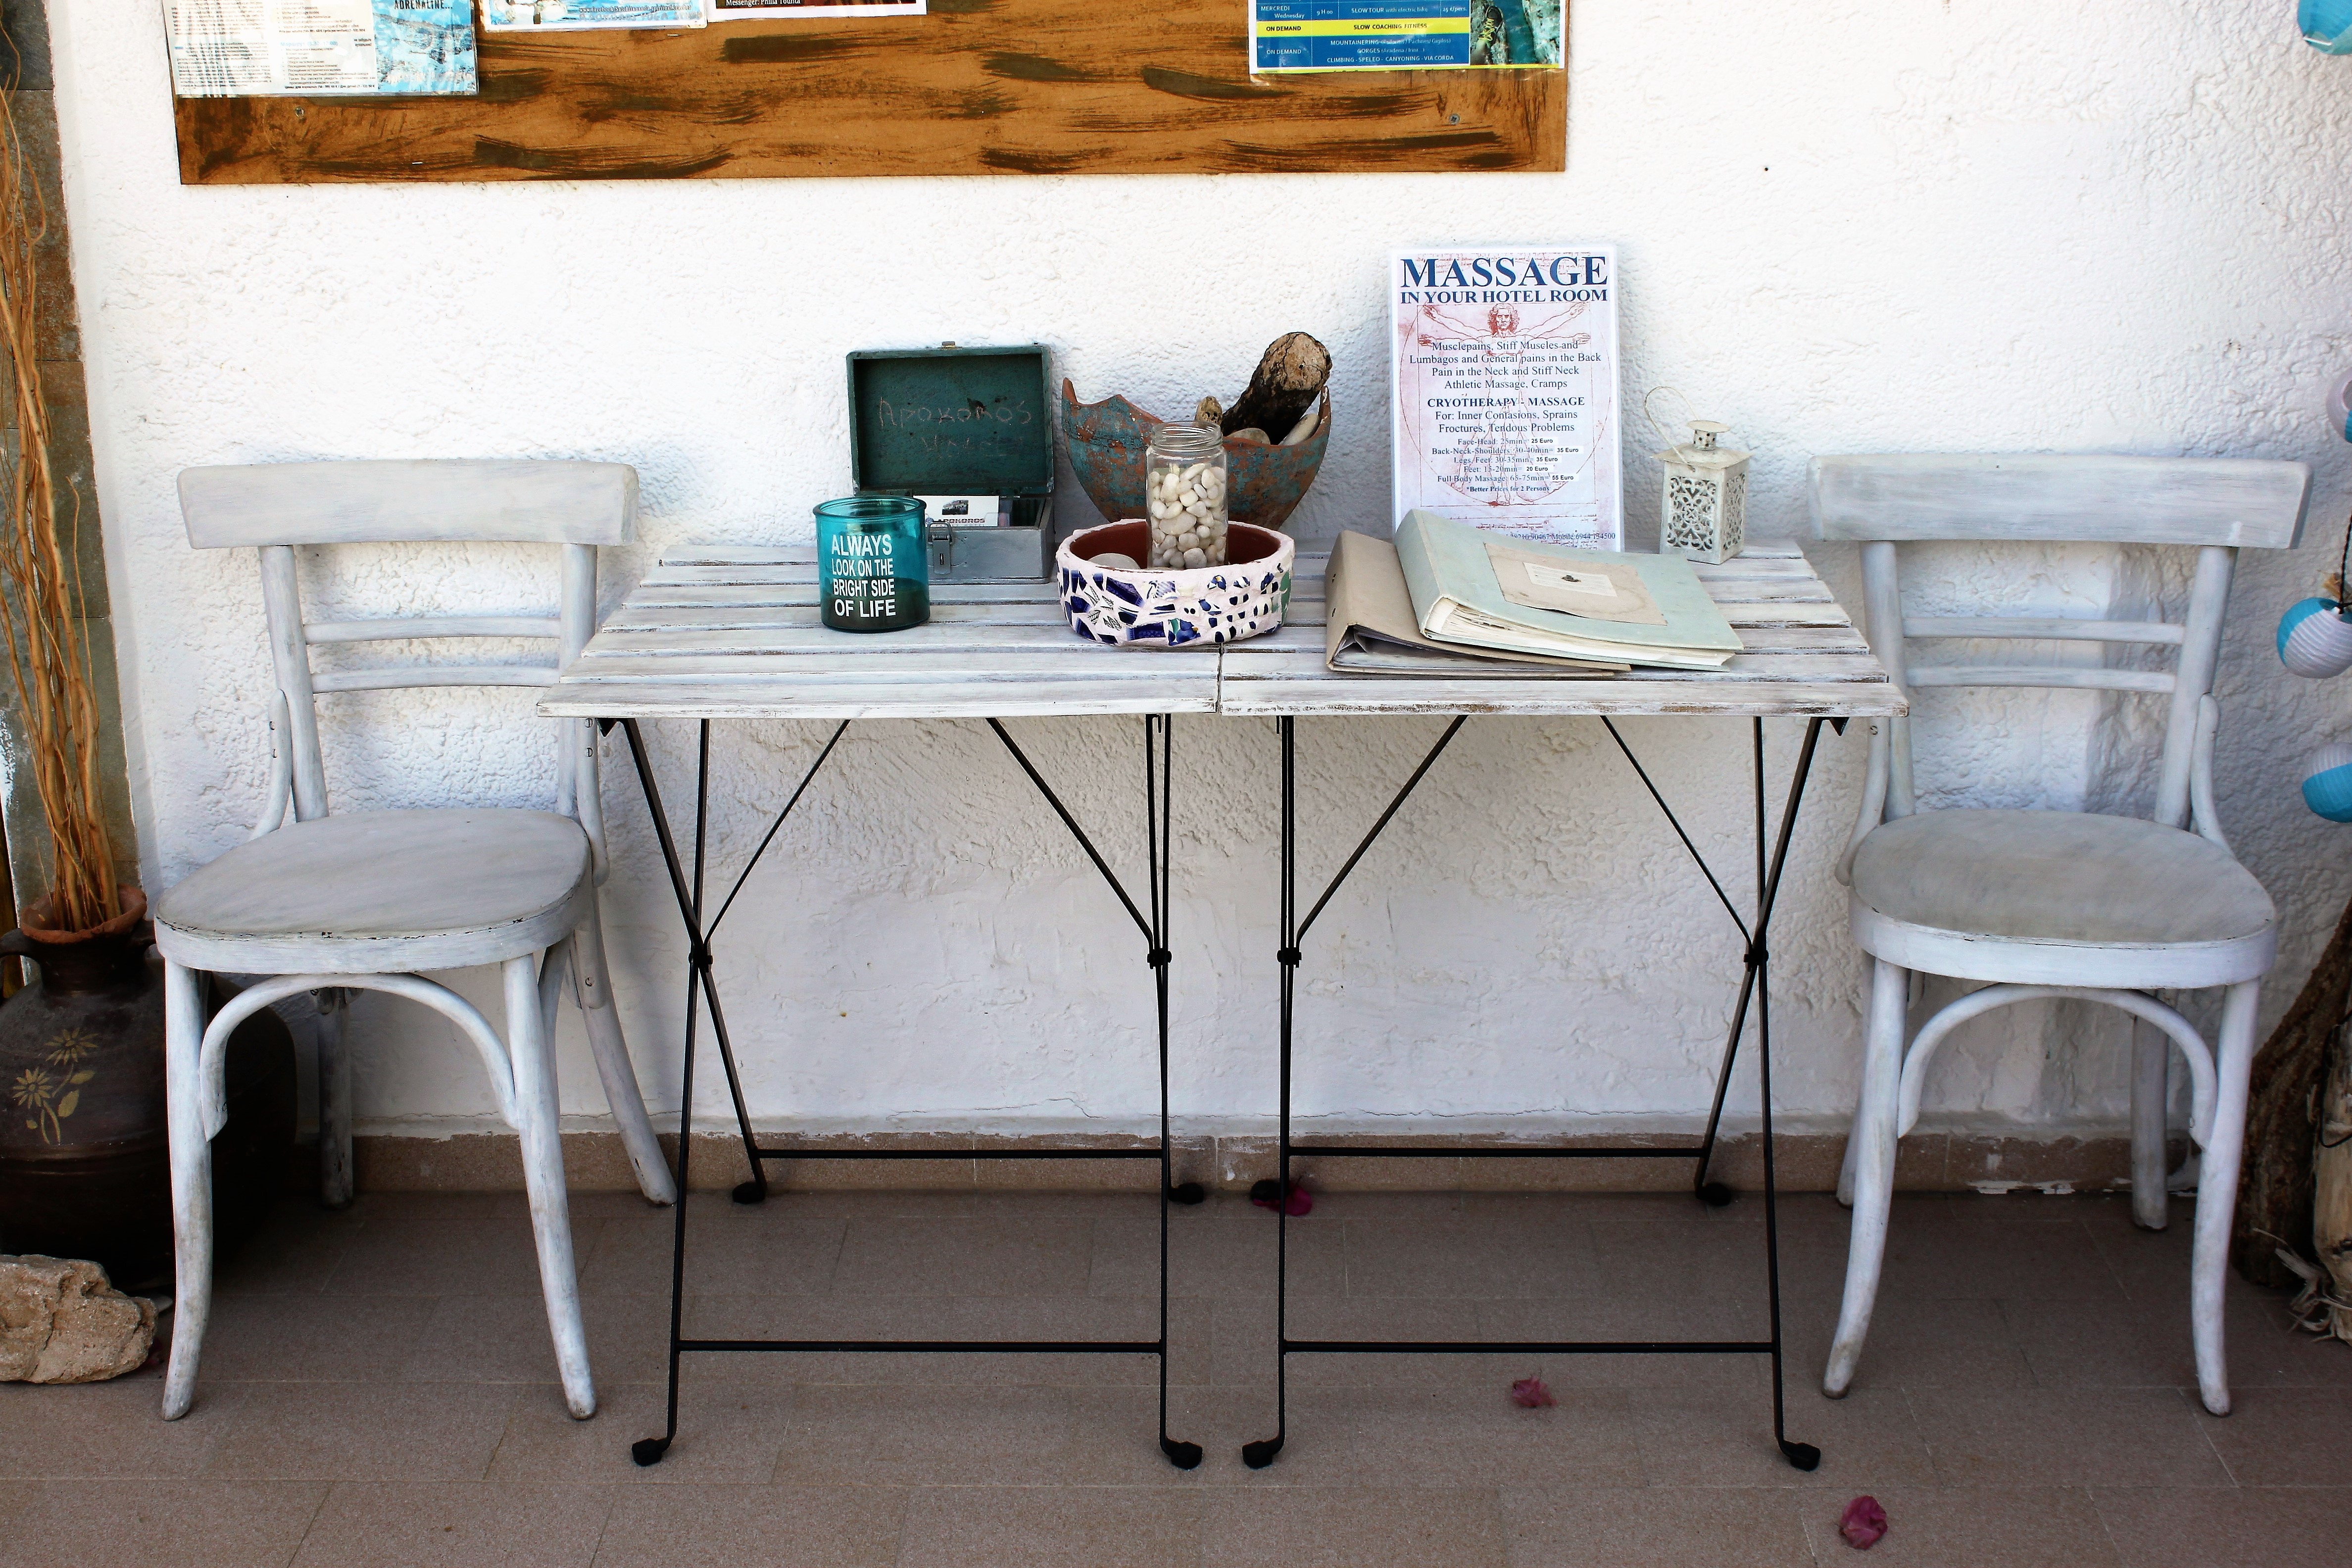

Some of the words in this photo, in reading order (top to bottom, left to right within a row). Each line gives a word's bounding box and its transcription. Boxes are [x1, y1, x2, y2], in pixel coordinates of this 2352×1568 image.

[394, 0, 452, 9] ADRENALINE...
[1400, 256, 1608, 288] MASSAGE
[1400, 292, 1419, 304] IN
[1424, 291, 1477, 304] YOUR
[1482, 290, 1545, 303] HOTEL
[1550, 289, 1608, 302] ROOM
[1432, 342, 1493, 352] Musclepains,
[1497, 341, 1518, 350] Stiff
[1520, 341, 1558, 350] Muscles
[1561, 340, 1578, 349] and
[1409, 355, 1458, 365] Lumbagos
[1461, 354, 1478, 363] and
[1481, 353, 1518, 363] General
[1521, 353, 1545, 365] pains
[1548, 353, 1558, 362] in
[1561, 353, 1575, 362] the
[1577, 352, 1602, 362] Back
[1432, 367, 1453, 376] Pain
[1456, 367, 1465, 376] in
[1467, 367, 1482, 376] the
[1484, 367, 1509, 376] Neck
[1512, 366, 1529, 375] and
[1532, 366, 1553, 375] Stiff
[1555, 366, 1579, 375] Neck
[1444, 379, 1482, 389] Athletic
[1531, 379, 1568, 390] Cramps
[1427, 397, 1518, 407] CRYOTHERAPY
[1527, 396, 1585, 406] MASSAGE
[1435, 411, 1455, 420] For:
[1458, 411, 1482, 420] Inner
[1542, 409, 1578, 420] Sprains
[1438, 424, 1485, 434] Froctures,
[1488, 423, 1527, 433] Tendous
[1531, 423, 1575, 432] Problems
[1454, 475, 1472, 484] Body
[831, 534, 892, 556] ALWAYS
[832, 558, 856, 577] LOOK
[858, 559, 873, 577] ON
[874, 558, 894, 577] THE
[833, 578, 868, 597] BRIGHT
[871, 578, 895, 597] SIDE
[834, 599, 854, 617] OF
[859, 598, 896, 617] LIFE
